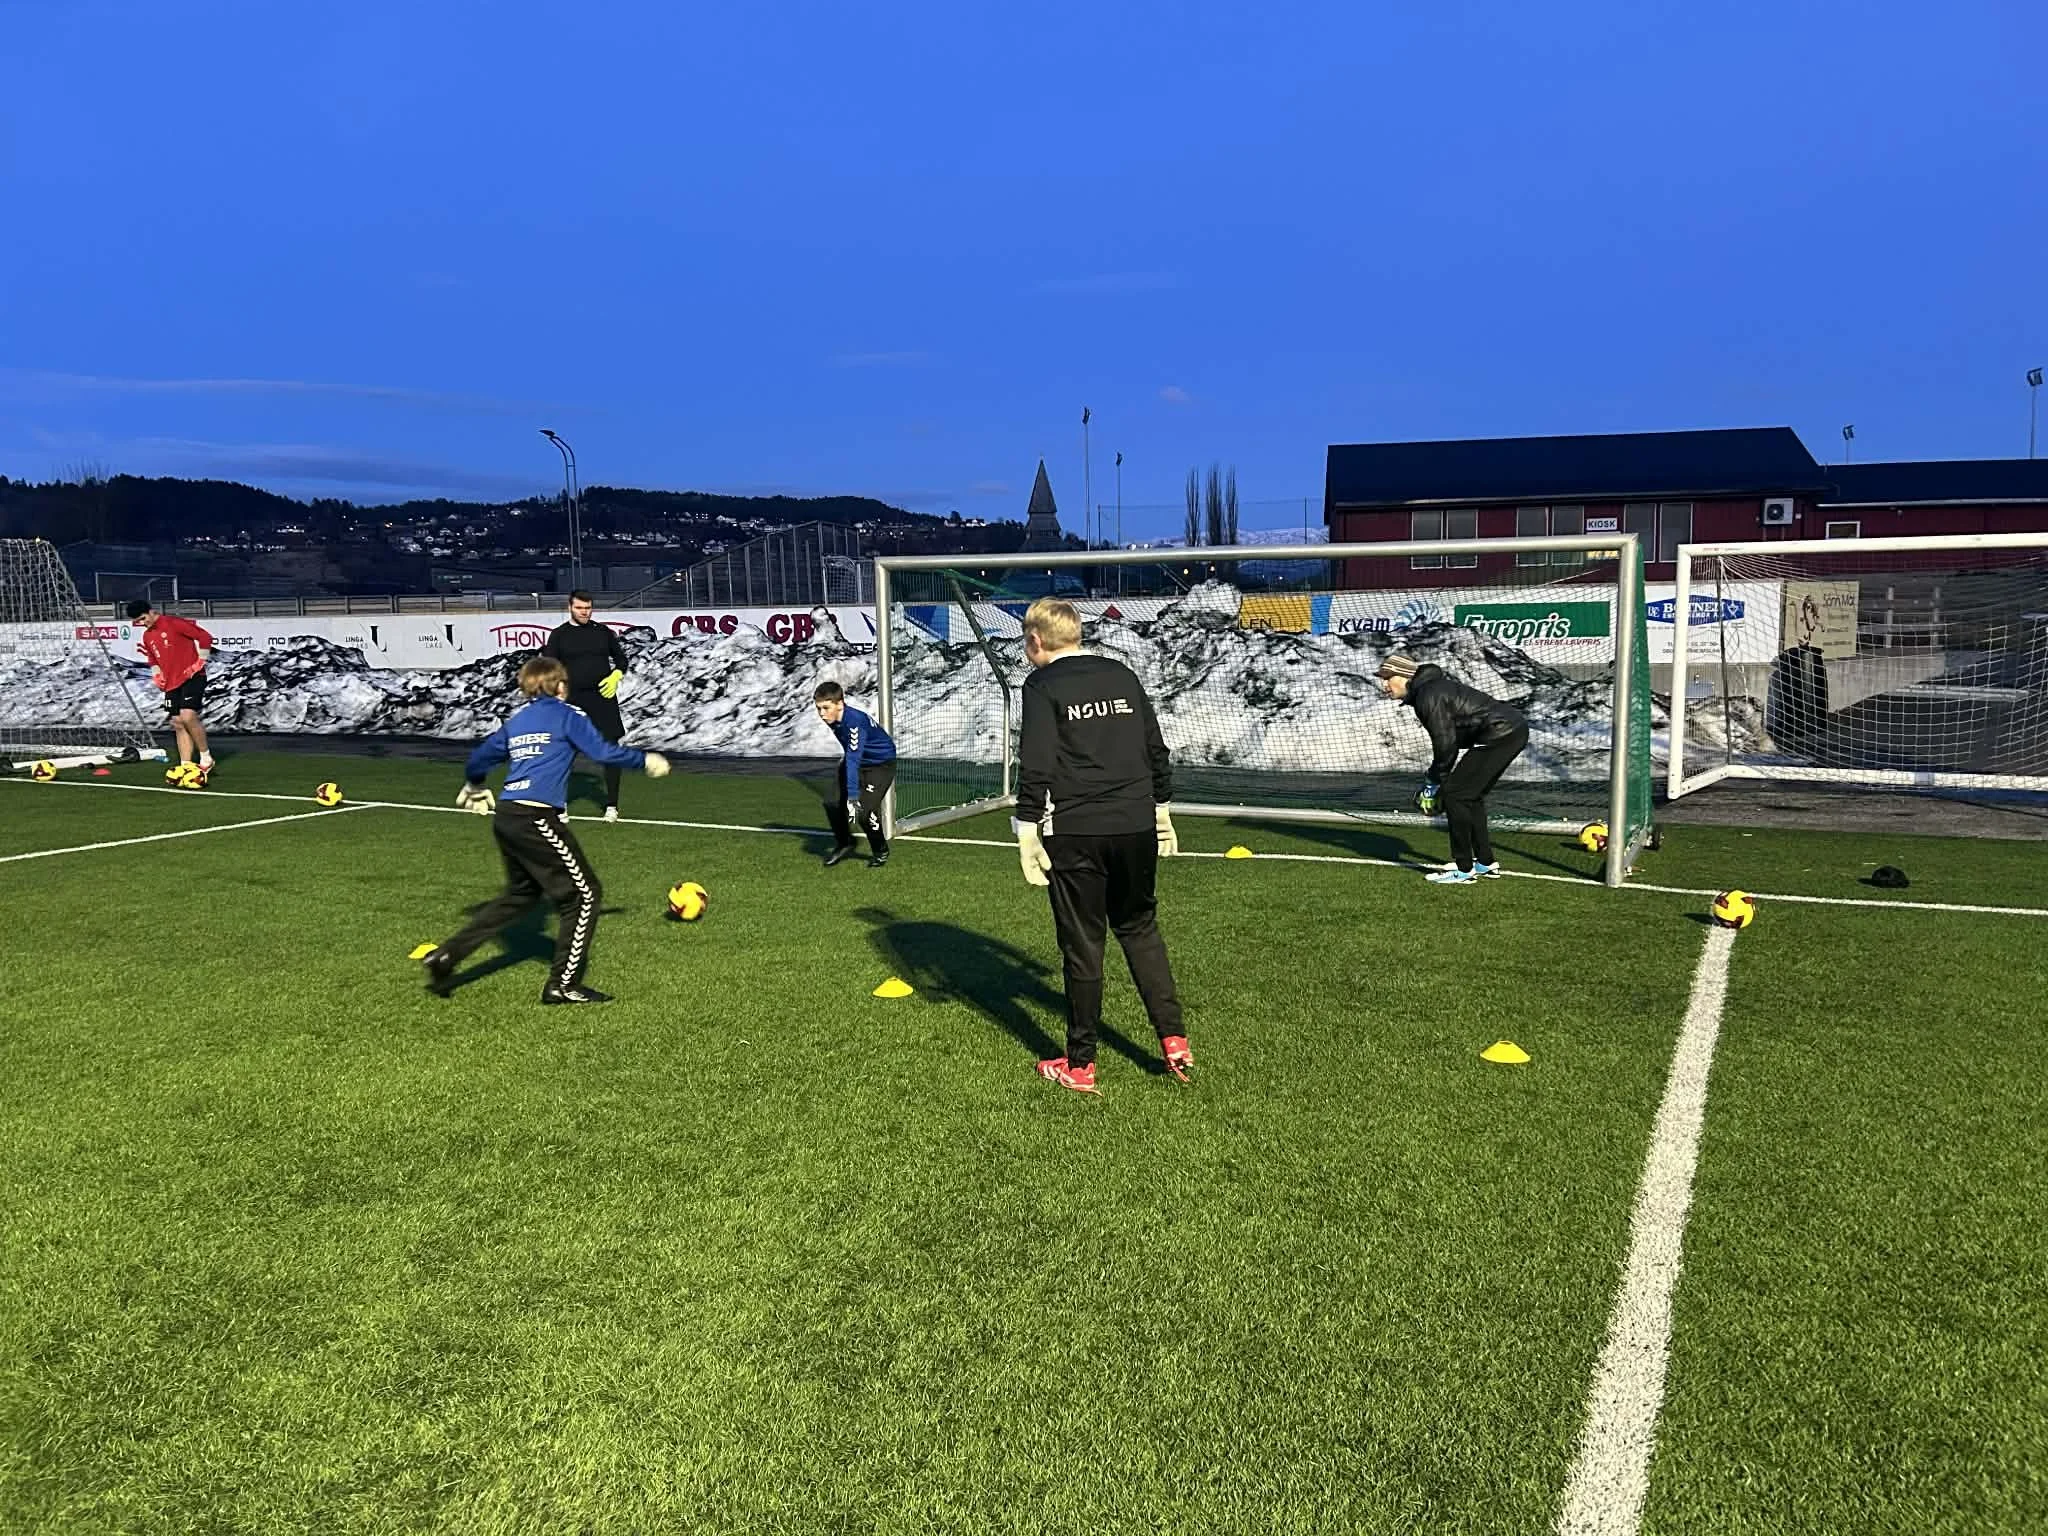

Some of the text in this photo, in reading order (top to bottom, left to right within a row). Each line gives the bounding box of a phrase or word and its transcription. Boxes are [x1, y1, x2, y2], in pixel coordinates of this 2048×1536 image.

[1588, 520, 1616, 528] KIOSK
[1464, 613, 1569, 646] Europris
[221, 635, 253, 649] sport
